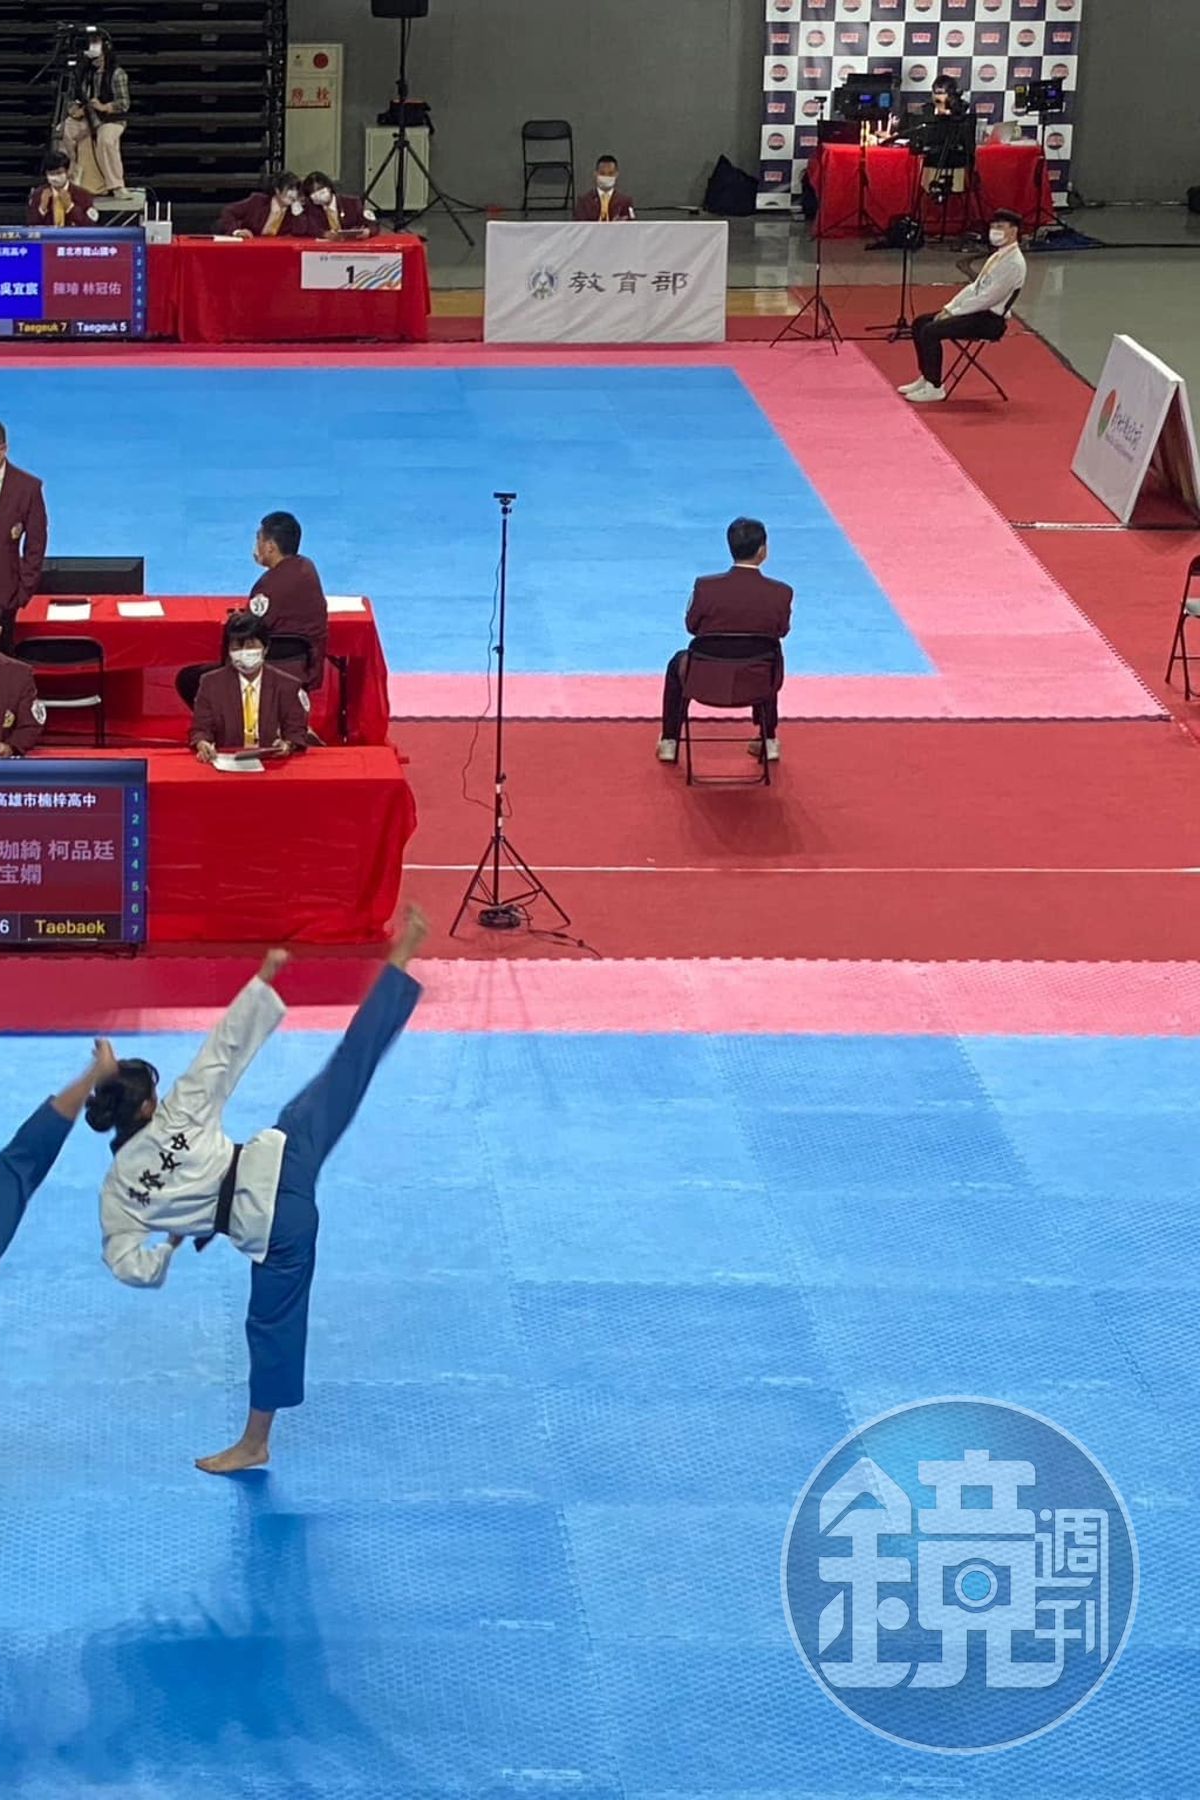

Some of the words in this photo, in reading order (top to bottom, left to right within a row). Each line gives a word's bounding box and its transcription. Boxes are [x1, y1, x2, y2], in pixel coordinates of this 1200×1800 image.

[346, 265, 355, 284] 1
[568, 271, 690, 296] 教育部
[18, 322, 59, 335] Taegeuk
[60, 322, 67, 332] 7
[77, 322, 118, 335] Taegeuk
[120, 321, 127, 332] 5
[131, 814, 139, 825] 2
[131, 836, 139, 847] 3
[48, 839, 115, 861] 柯品廷
[131, 859, 139, 870] 4
[131, 881, 139, 892] 5
[131, 904, 139, 914] 6
[0, 919, 10, 934] 6
[35, 919, 106, 935] Taebaek
[131, 925, 139, 936] 7
